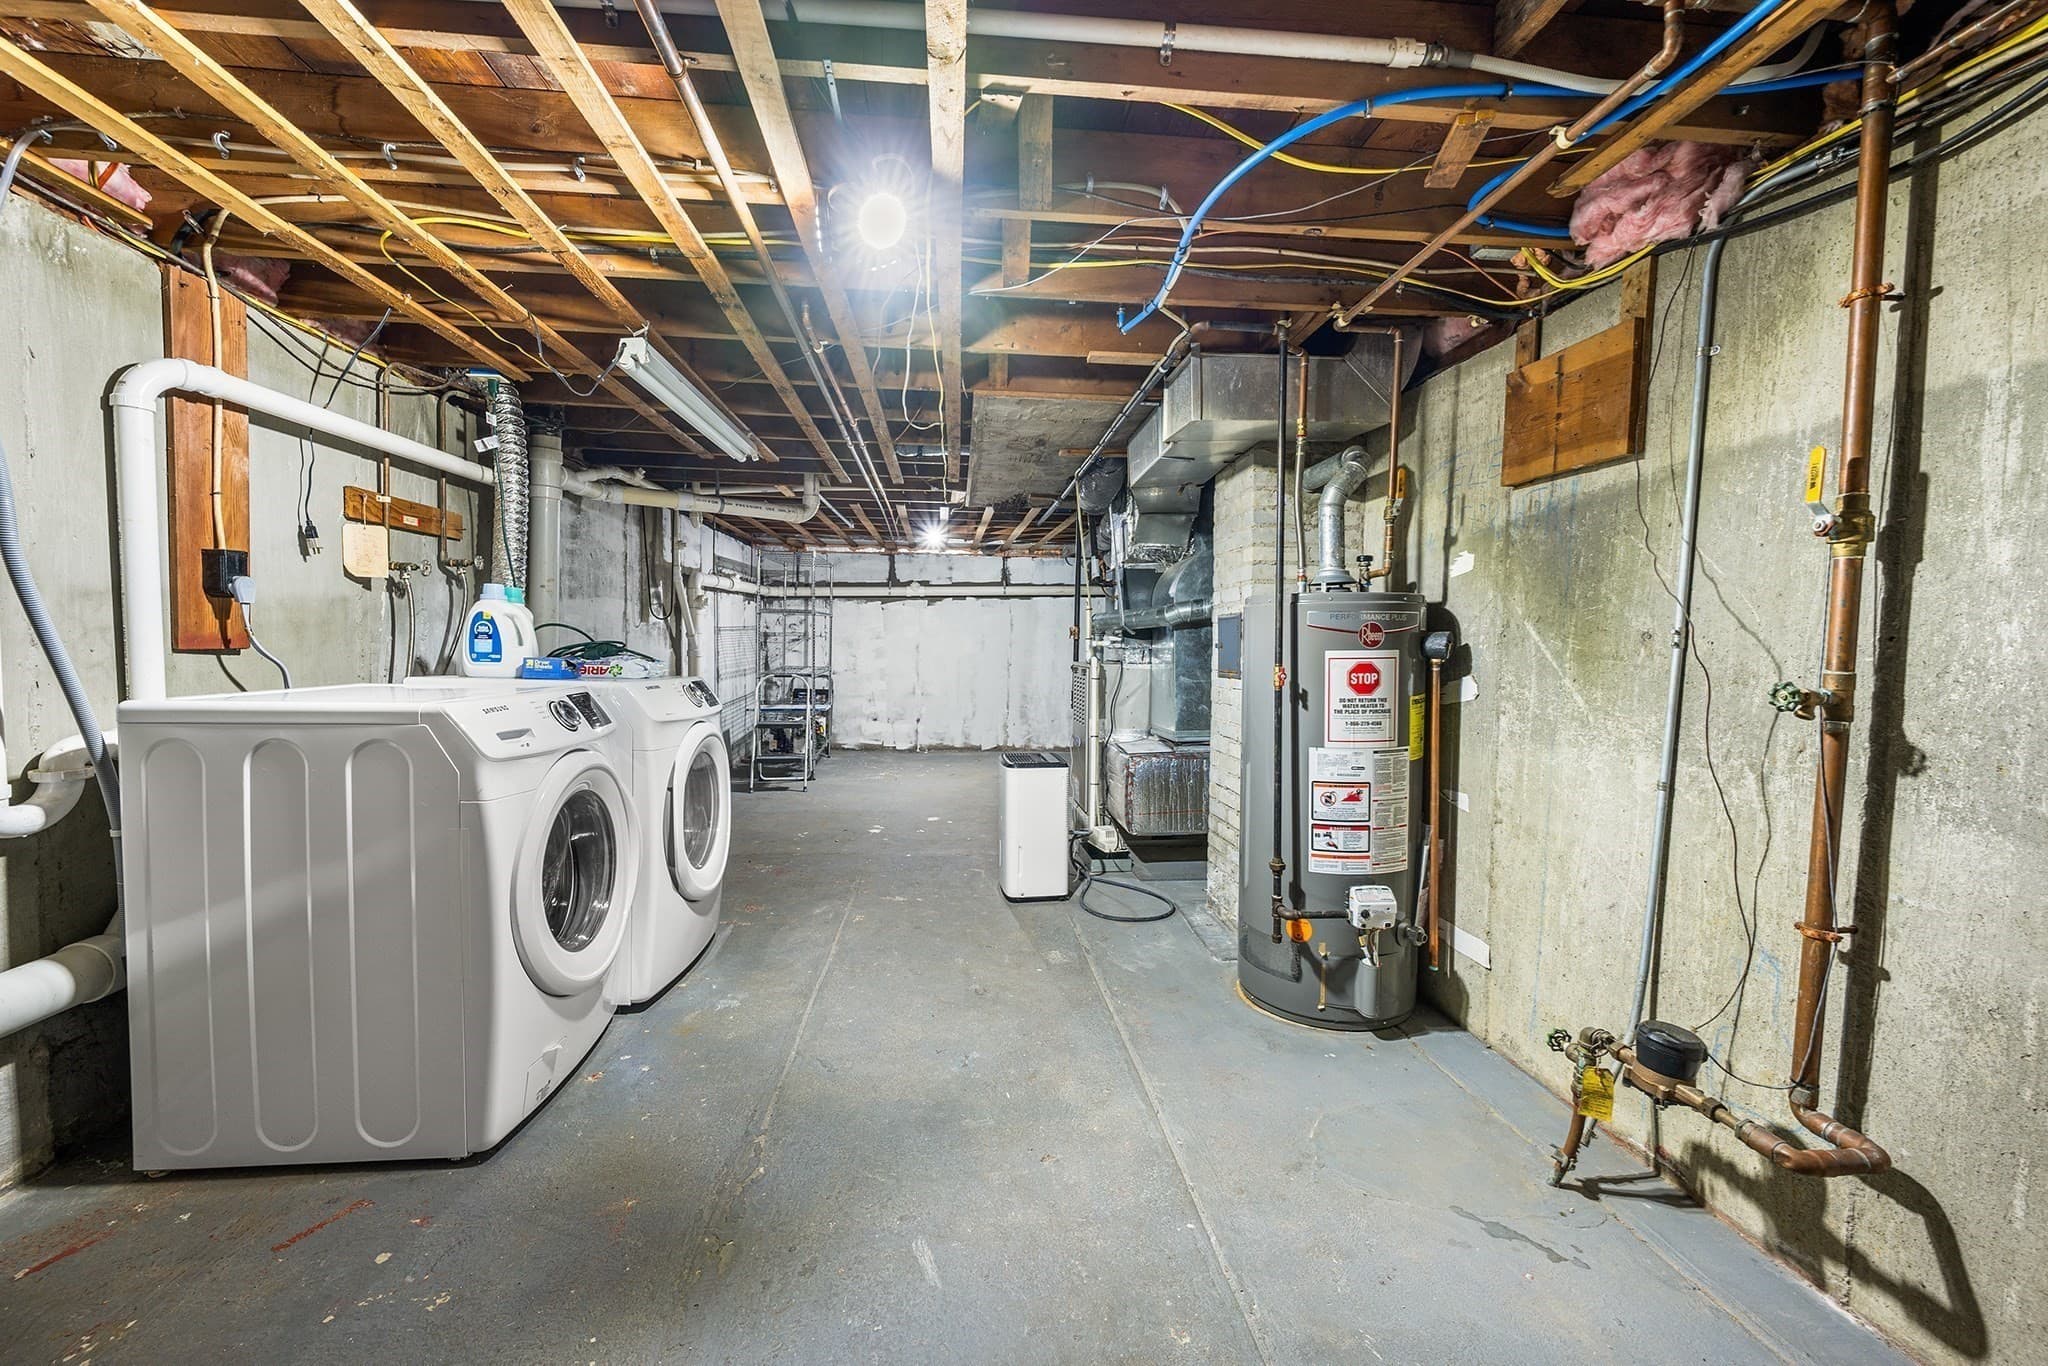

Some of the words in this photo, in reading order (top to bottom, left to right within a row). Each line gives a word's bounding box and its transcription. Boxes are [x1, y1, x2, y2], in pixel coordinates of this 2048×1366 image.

[1329, 613, 1391, 621] PERFRMANCE
[580, 664, 610, 675] ARIE
[1350, 673, 1378, 685] STOP
